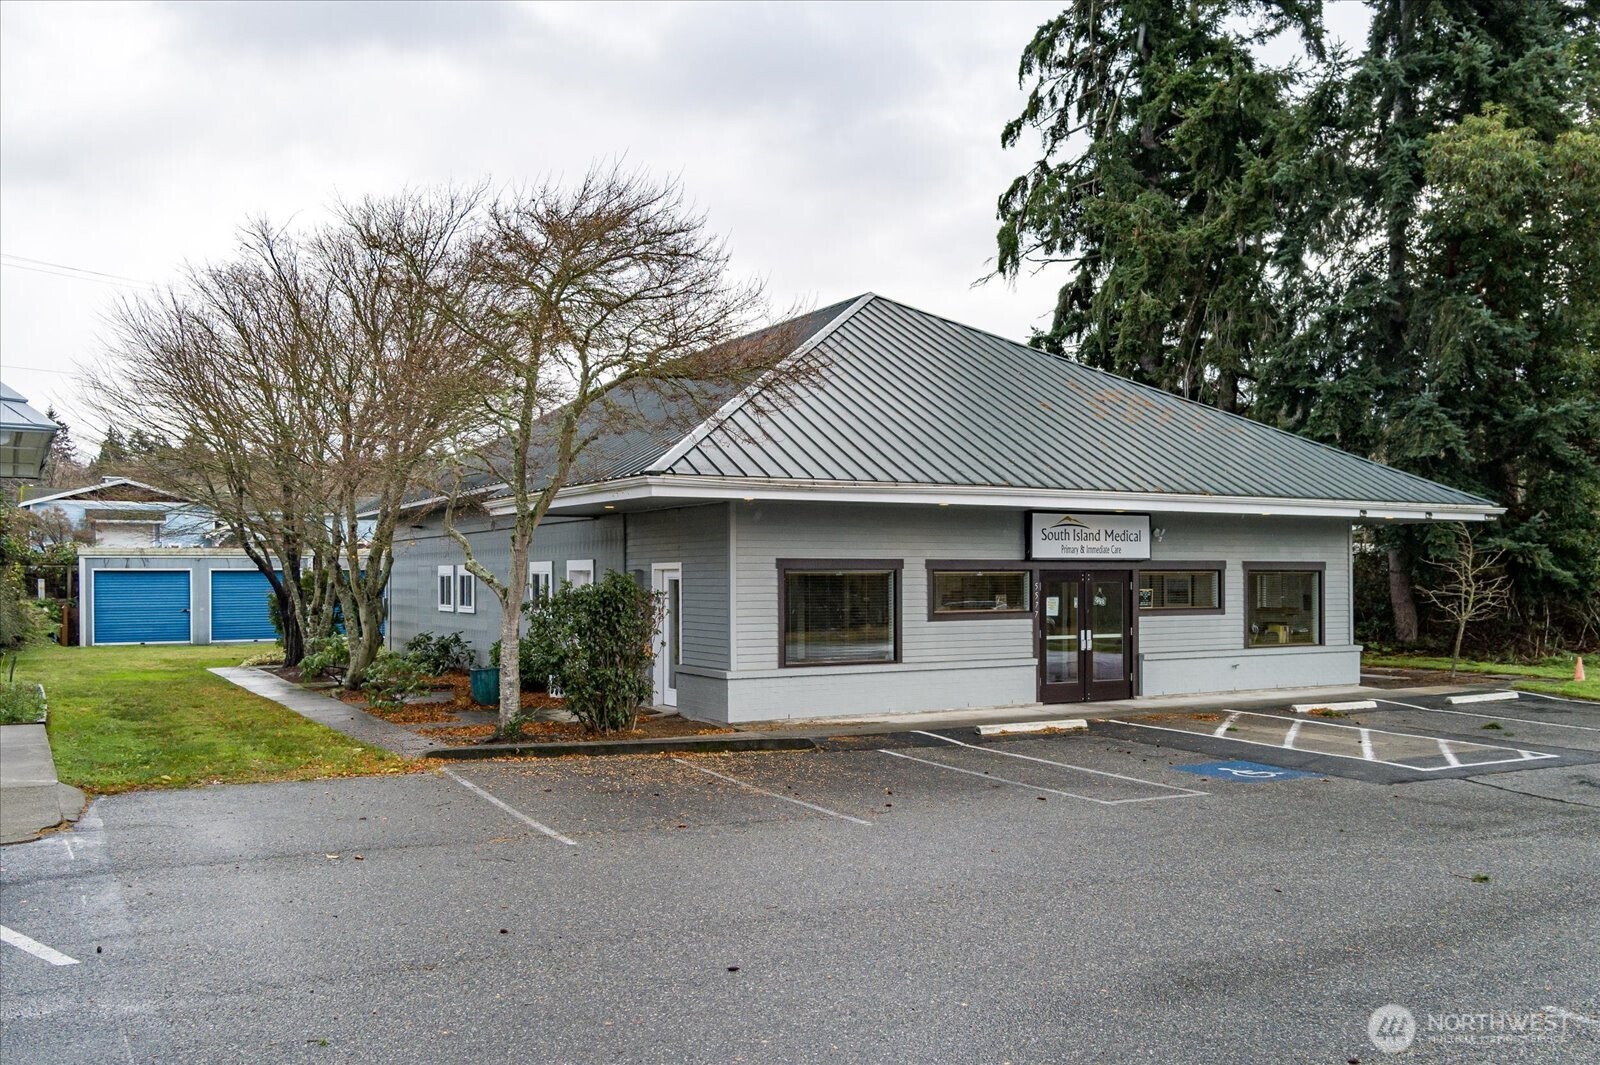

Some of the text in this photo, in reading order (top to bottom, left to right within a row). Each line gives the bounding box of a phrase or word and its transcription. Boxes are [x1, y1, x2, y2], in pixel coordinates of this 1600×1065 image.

[1041, 528, 1142, 542] South Island Medical
[1061, 545, 1122, 555] Primary & Immediate Care
